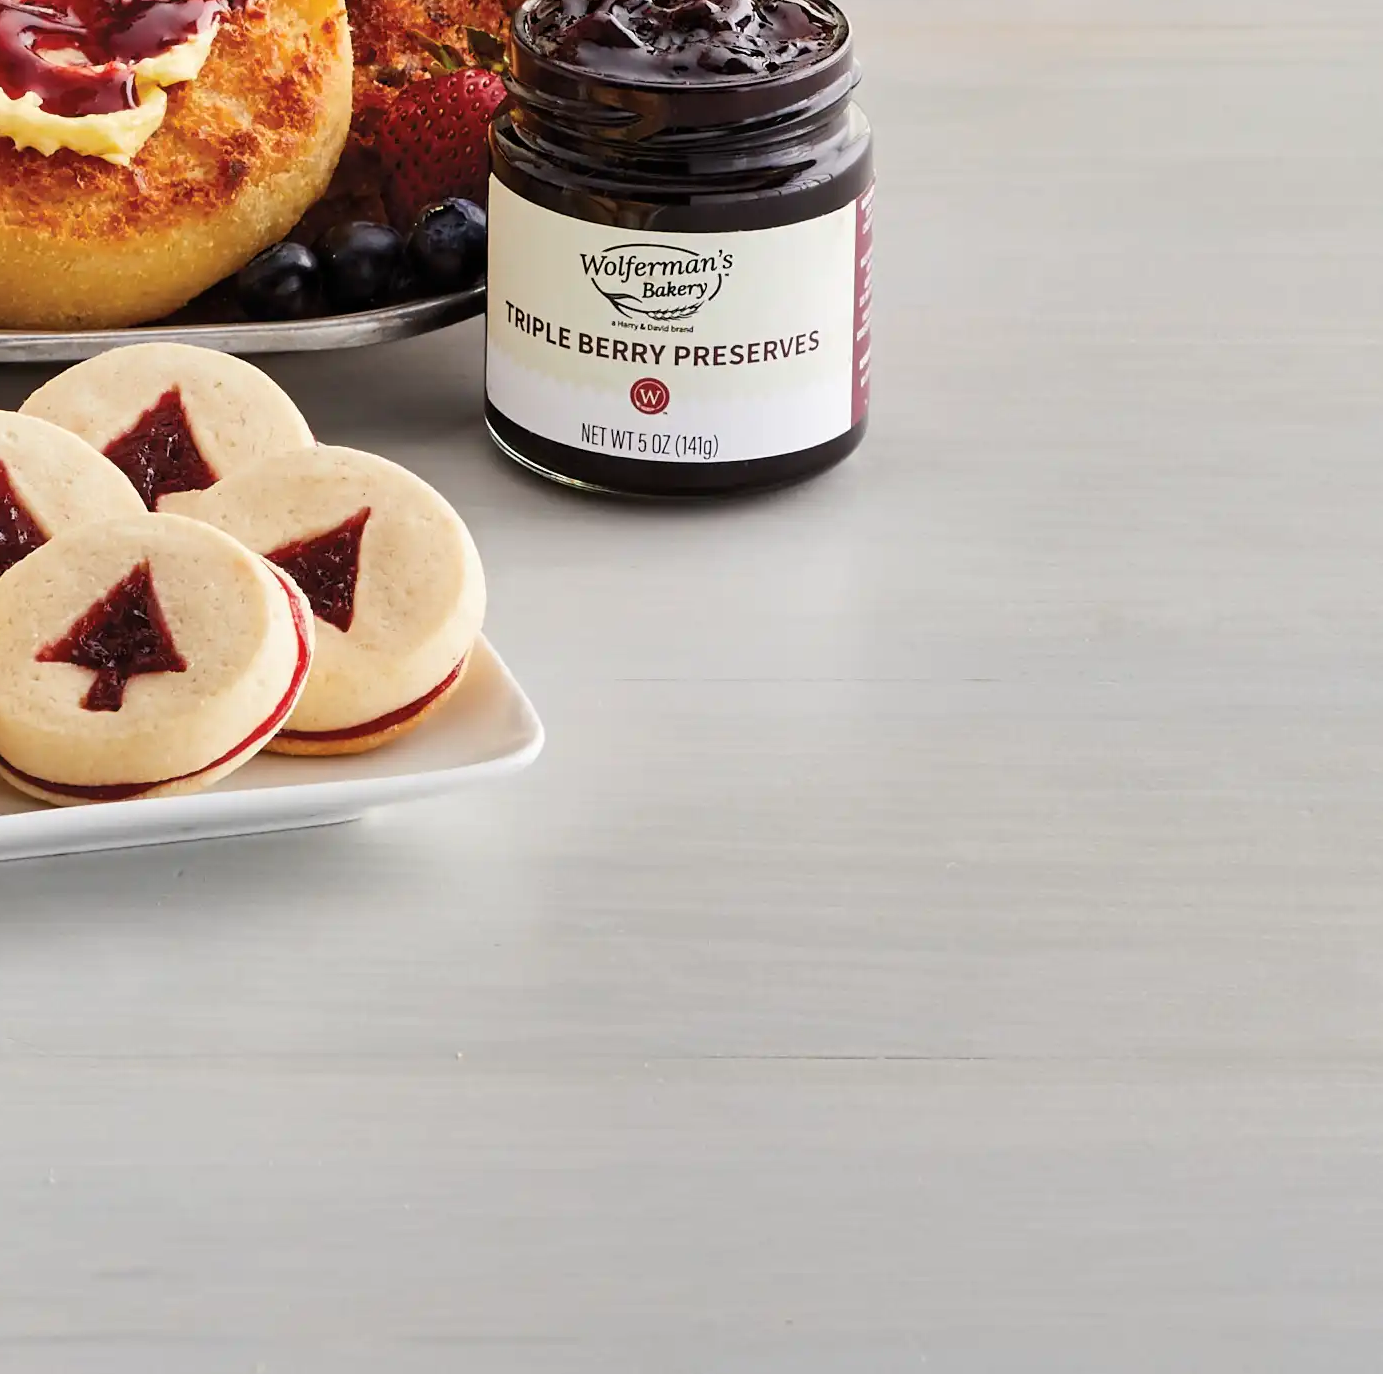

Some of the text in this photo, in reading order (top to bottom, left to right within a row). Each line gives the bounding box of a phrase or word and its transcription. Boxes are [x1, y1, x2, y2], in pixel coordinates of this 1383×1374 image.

[580, 249, 733, 283] Wolferman's
[642, 281, 708, 299] Bakery
[504, 300, 820, 367] TRIPLE BERRY PRESERVES
[618, 320, 638, 331] Harry
[647, 324, 669, 333] David
[671, 325, 694, 333] brand
[639, 388, 661, 405] W
[581, 422, 719, 460] NET WT 5 OZ (141g)
